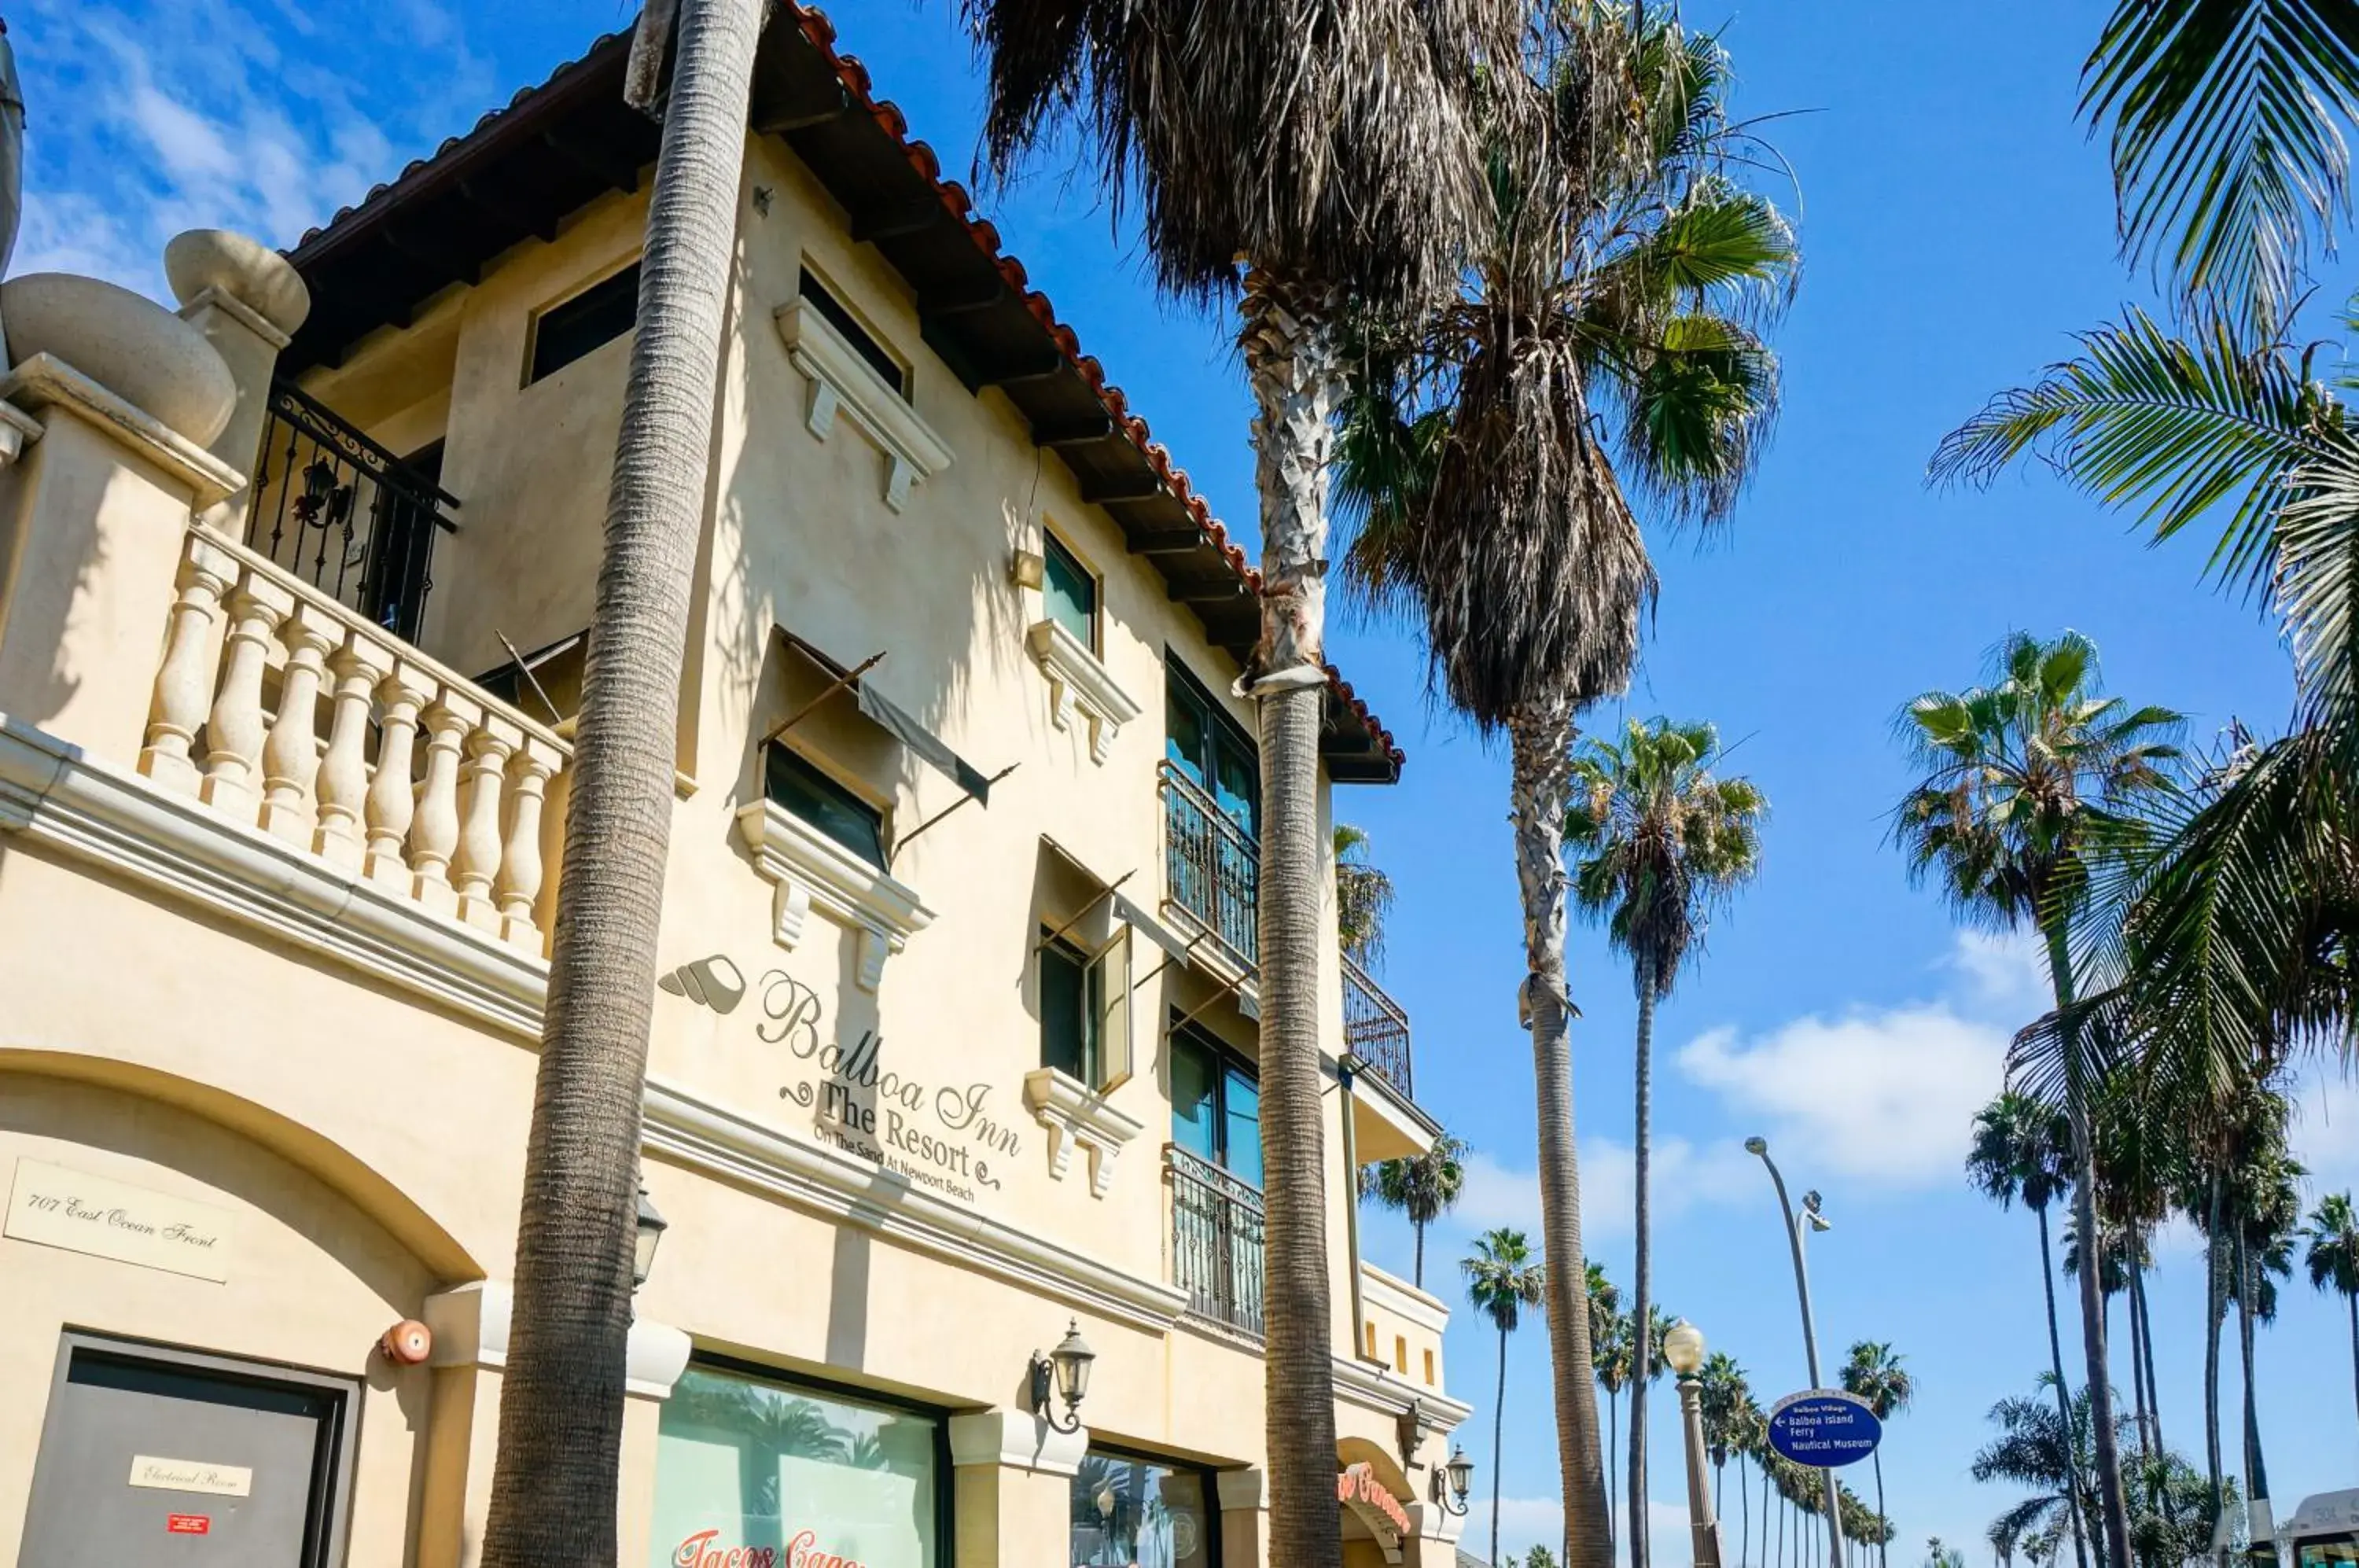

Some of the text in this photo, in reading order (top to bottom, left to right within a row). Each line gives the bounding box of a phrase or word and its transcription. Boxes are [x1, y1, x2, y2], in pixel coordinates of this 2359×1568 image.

[756, 969, 1021, 1158] Balboa Inn
[823, 1080, 970, 1177] The Resort
[814, 1124, 974, 1203] On The Sand At Newport Beach
[28, 1194, 218, 1248] 707 East Ocean Front
[1789, 1414, 1853, 1426] Balboa Island
[1820, 1404, 1847, 1413] Village
[1790, 1427, 1815, 1437] Ferry
[1792, 1439, 1872, 1450] Nautical Museum
[676, 1529, 778, 1568] Tacos
